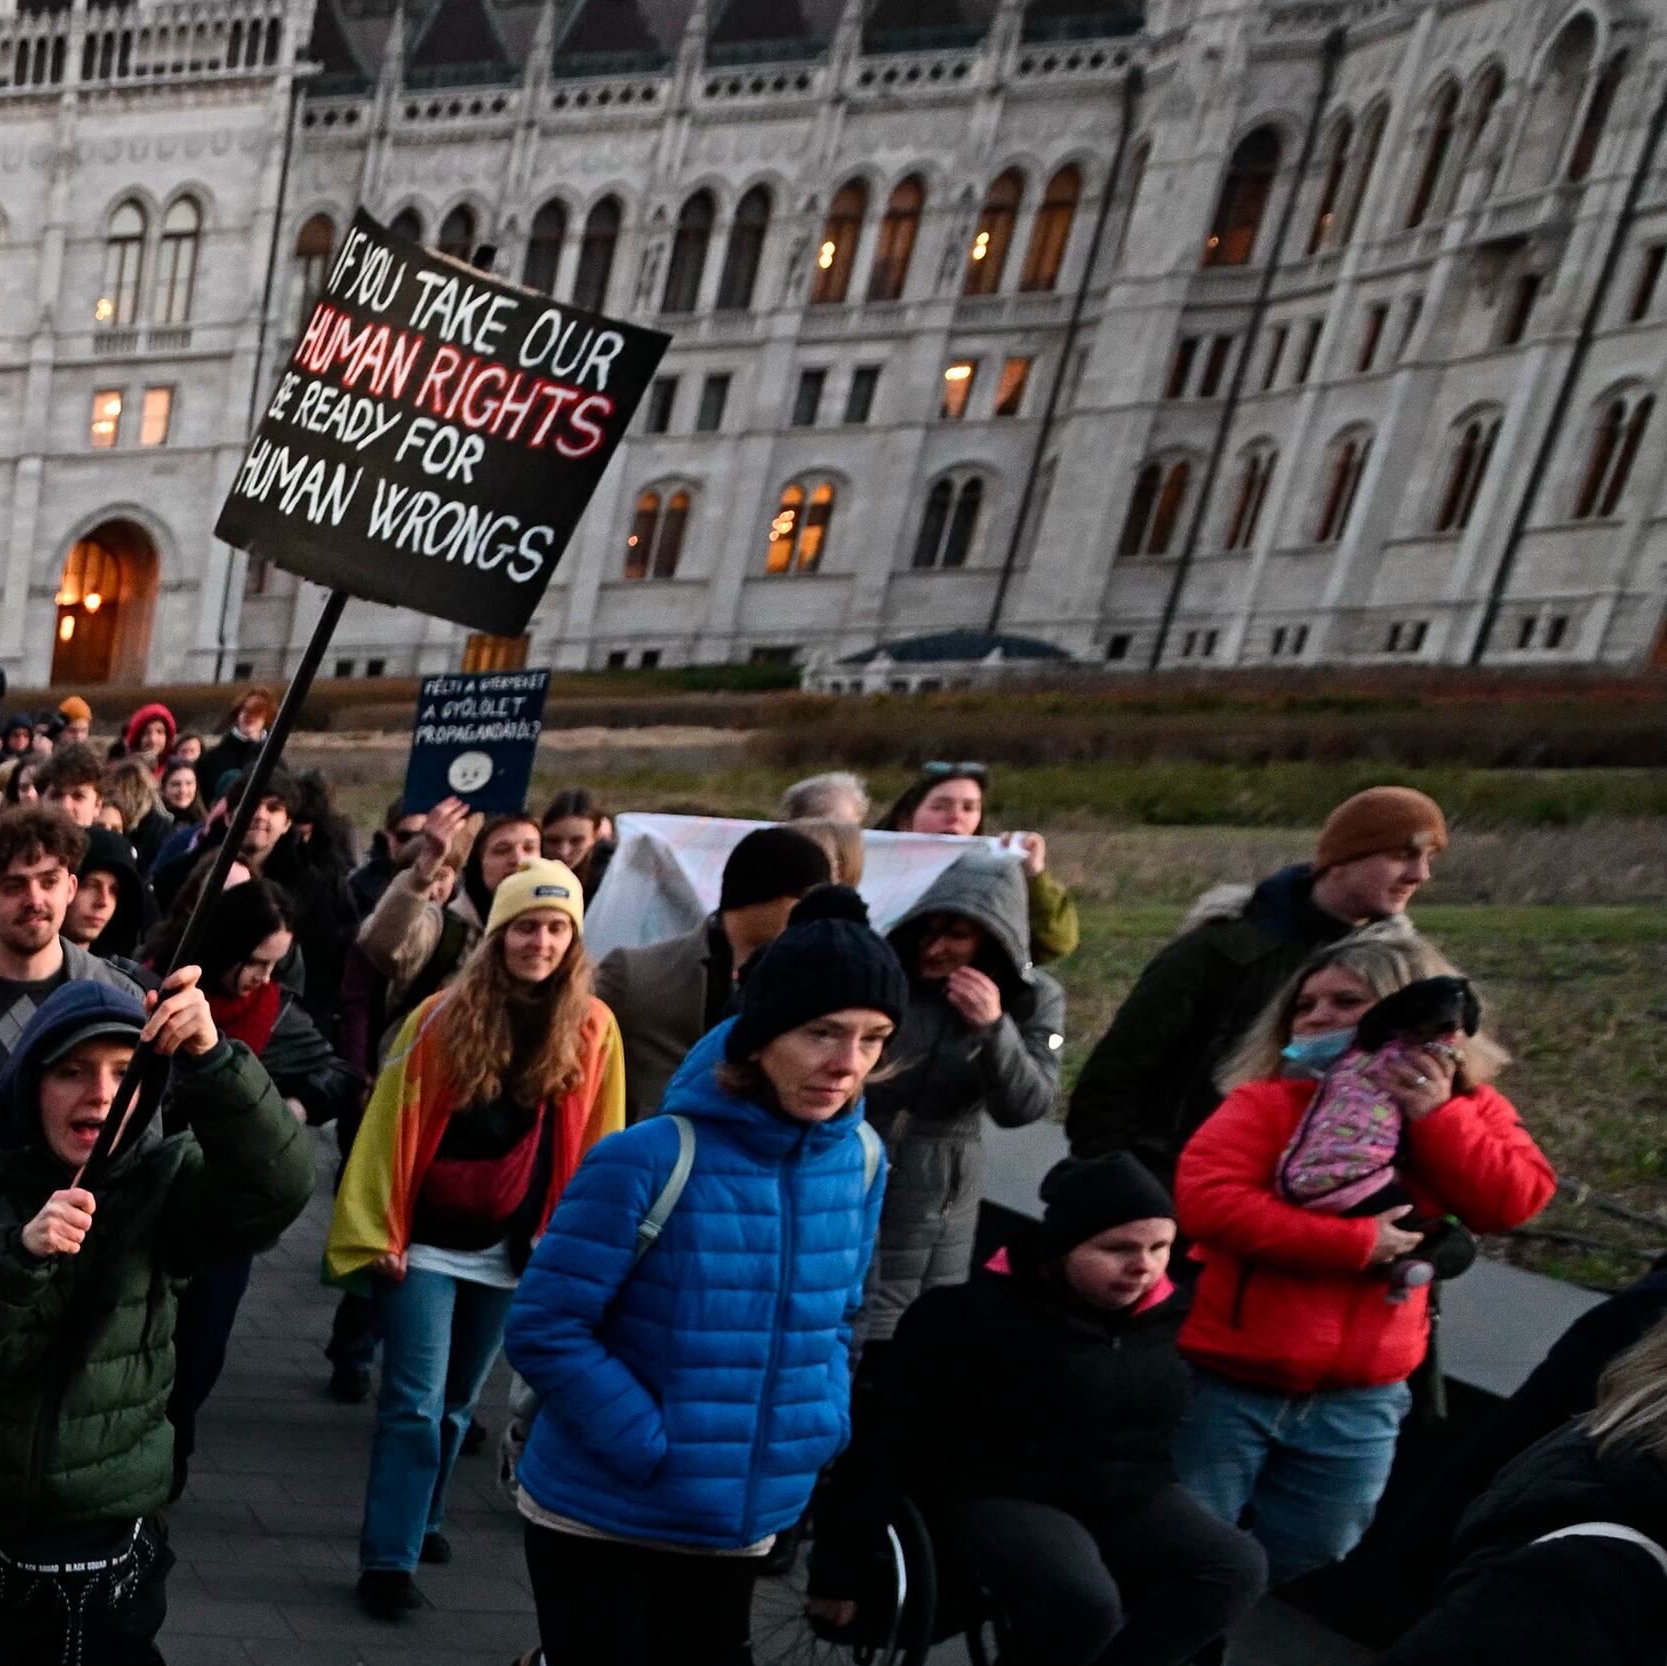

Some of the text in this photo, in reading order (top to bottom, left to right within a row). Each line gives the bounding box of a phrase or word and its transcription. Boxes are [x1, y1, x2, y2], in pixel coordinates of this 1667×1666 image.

[327, 226, 625, 391] IF YOU TAKE OUR
[268, 371, 486, 484] BE READY FOR
[294, 302, 617, 460] HUMAN RIGHTS
[234, 434, 555, 584] HUMAN WRONGS
[421, 704, 436, 720] A
[464, 680, 476, 693] A
[65, 1563, 85, 1572] BLACK
[87, 1560, 107, 1570] SQUAD
